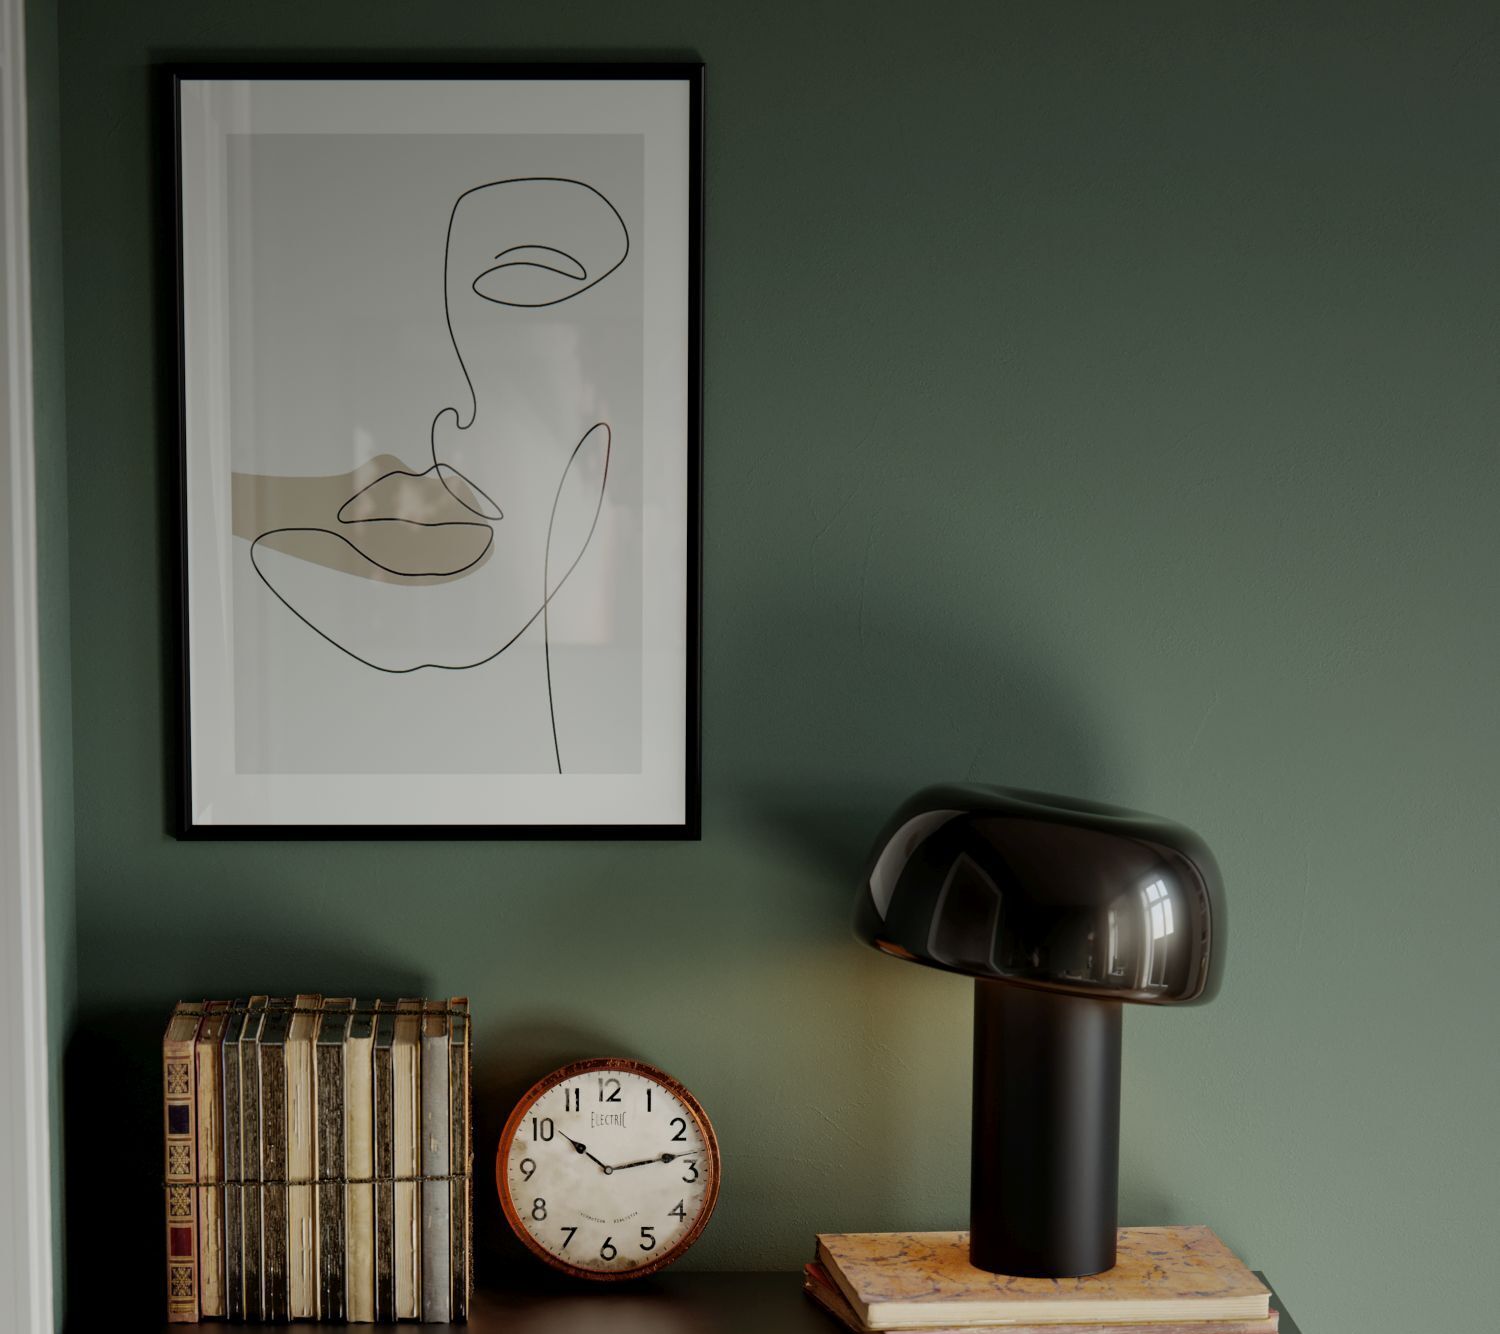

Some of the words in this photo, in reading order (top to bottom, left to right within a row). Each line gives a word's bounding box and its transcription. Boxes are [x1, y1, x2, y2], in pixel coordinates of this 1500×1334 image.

[565, 1088, 579, 1112] 11
[598, 1078, 621, 1102] 12
[646, 1088, 652, 1112] 1
[532, 1118, 554, 1141] 10
[591, 1112, 626, 1128] ELECTRIC
[669, 1118, 687, 1141] 2
[520, 1158, 536, 1181] 9
[682, 1160, 699, 1183] 3
[532, 1198, 547, 1221] 8
[667, 1199, 687, 1222] 4
[560, 1227, 578, 1248] 7
[600, 1237, 617, 1261] 6
[640, 1227, 656, 1250] 5
